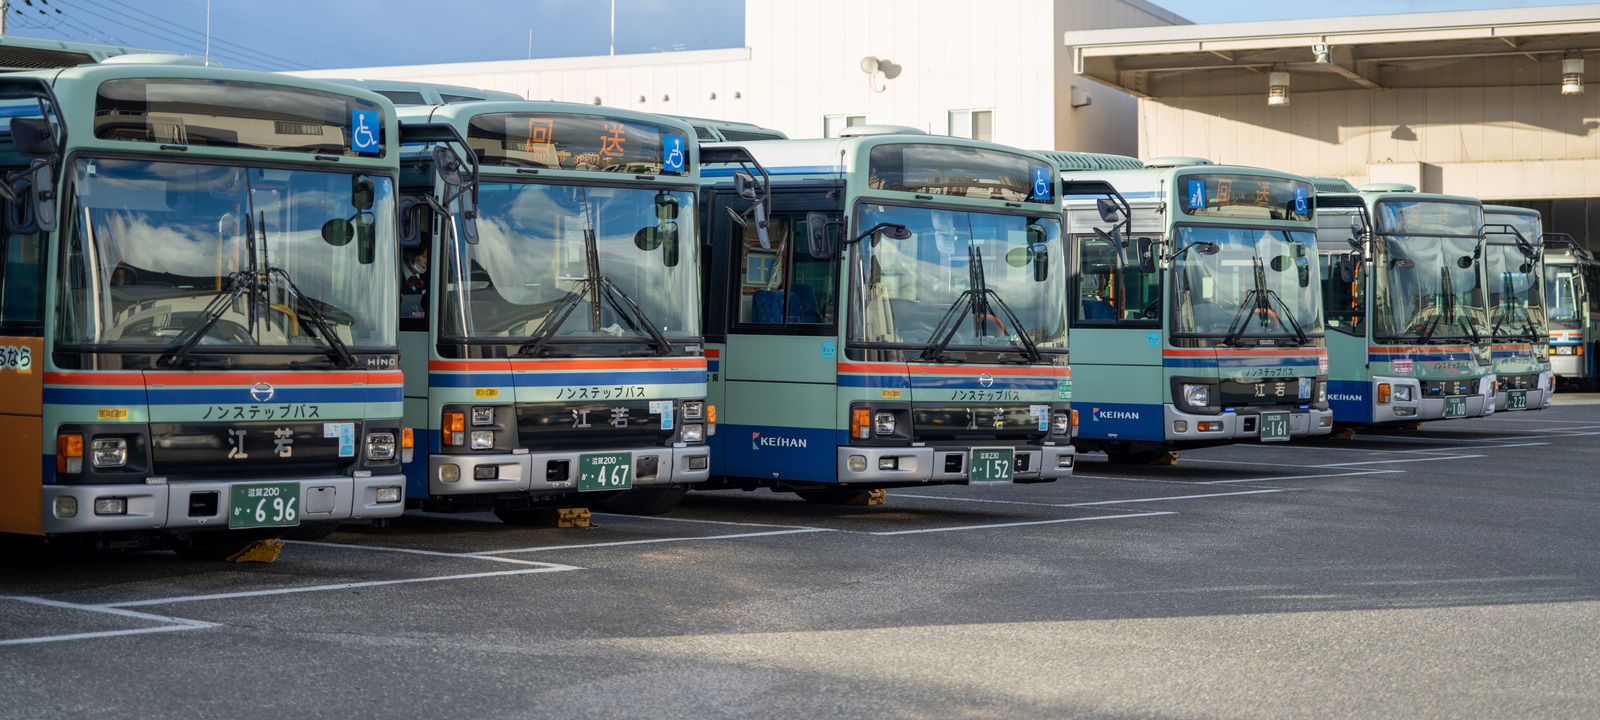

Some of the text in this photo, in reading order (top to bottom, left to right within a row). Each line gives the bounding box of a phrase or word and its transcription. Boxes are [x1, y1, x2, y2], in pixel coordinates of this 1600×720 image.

[534, 153, 551, 162] OUT
[557, 154, 567, 163] OF
[367, 358, 396, 366] HINO
[1245, 367, 1294, 377] ノンステップバス
[556, 385, 646, 400] ノンステップバス
[951, 389, 1020, 401] ノンステップバス
[1254, 382, 1285, 397] 江若
[1327, 393, 1362, 401] KEIHAN
[202, 403, 320, 420] ノンステップバス
[1100, 410, 1139, 420] KEIHAN
[571, 406, 629, 429] 江若
[227, 427, 294, 459] 江若
[760, 436, 807, 448] KEIHAN
[247, 487, 280, 497] 滋賀200
[234, 507, 242, 516] か
